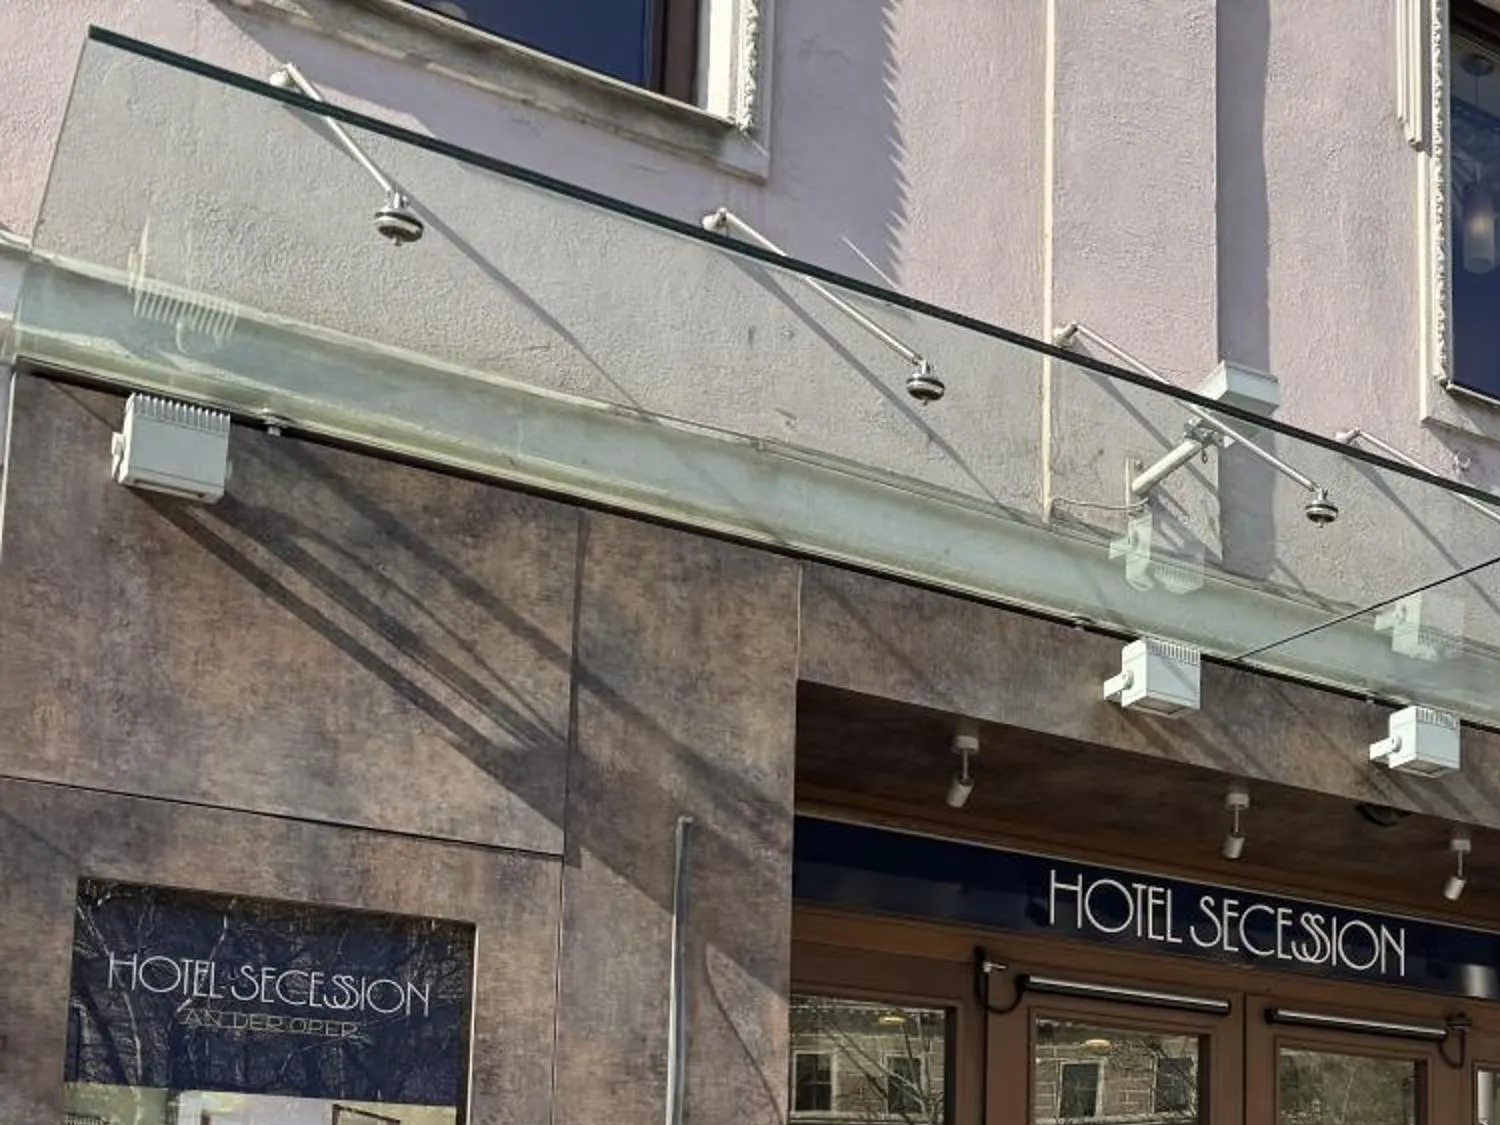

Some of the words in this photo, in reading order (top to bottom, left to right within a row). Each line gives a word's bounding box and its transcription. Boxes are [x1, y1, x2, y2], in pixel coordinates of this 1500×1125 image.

[1050, 869, 1183, 944] HOTEL
[1190, 895, 1405, 977] SECESSION
[108, 951, 224, 999] HOTEL
[231, 965, 430, 1017] SECESSION
